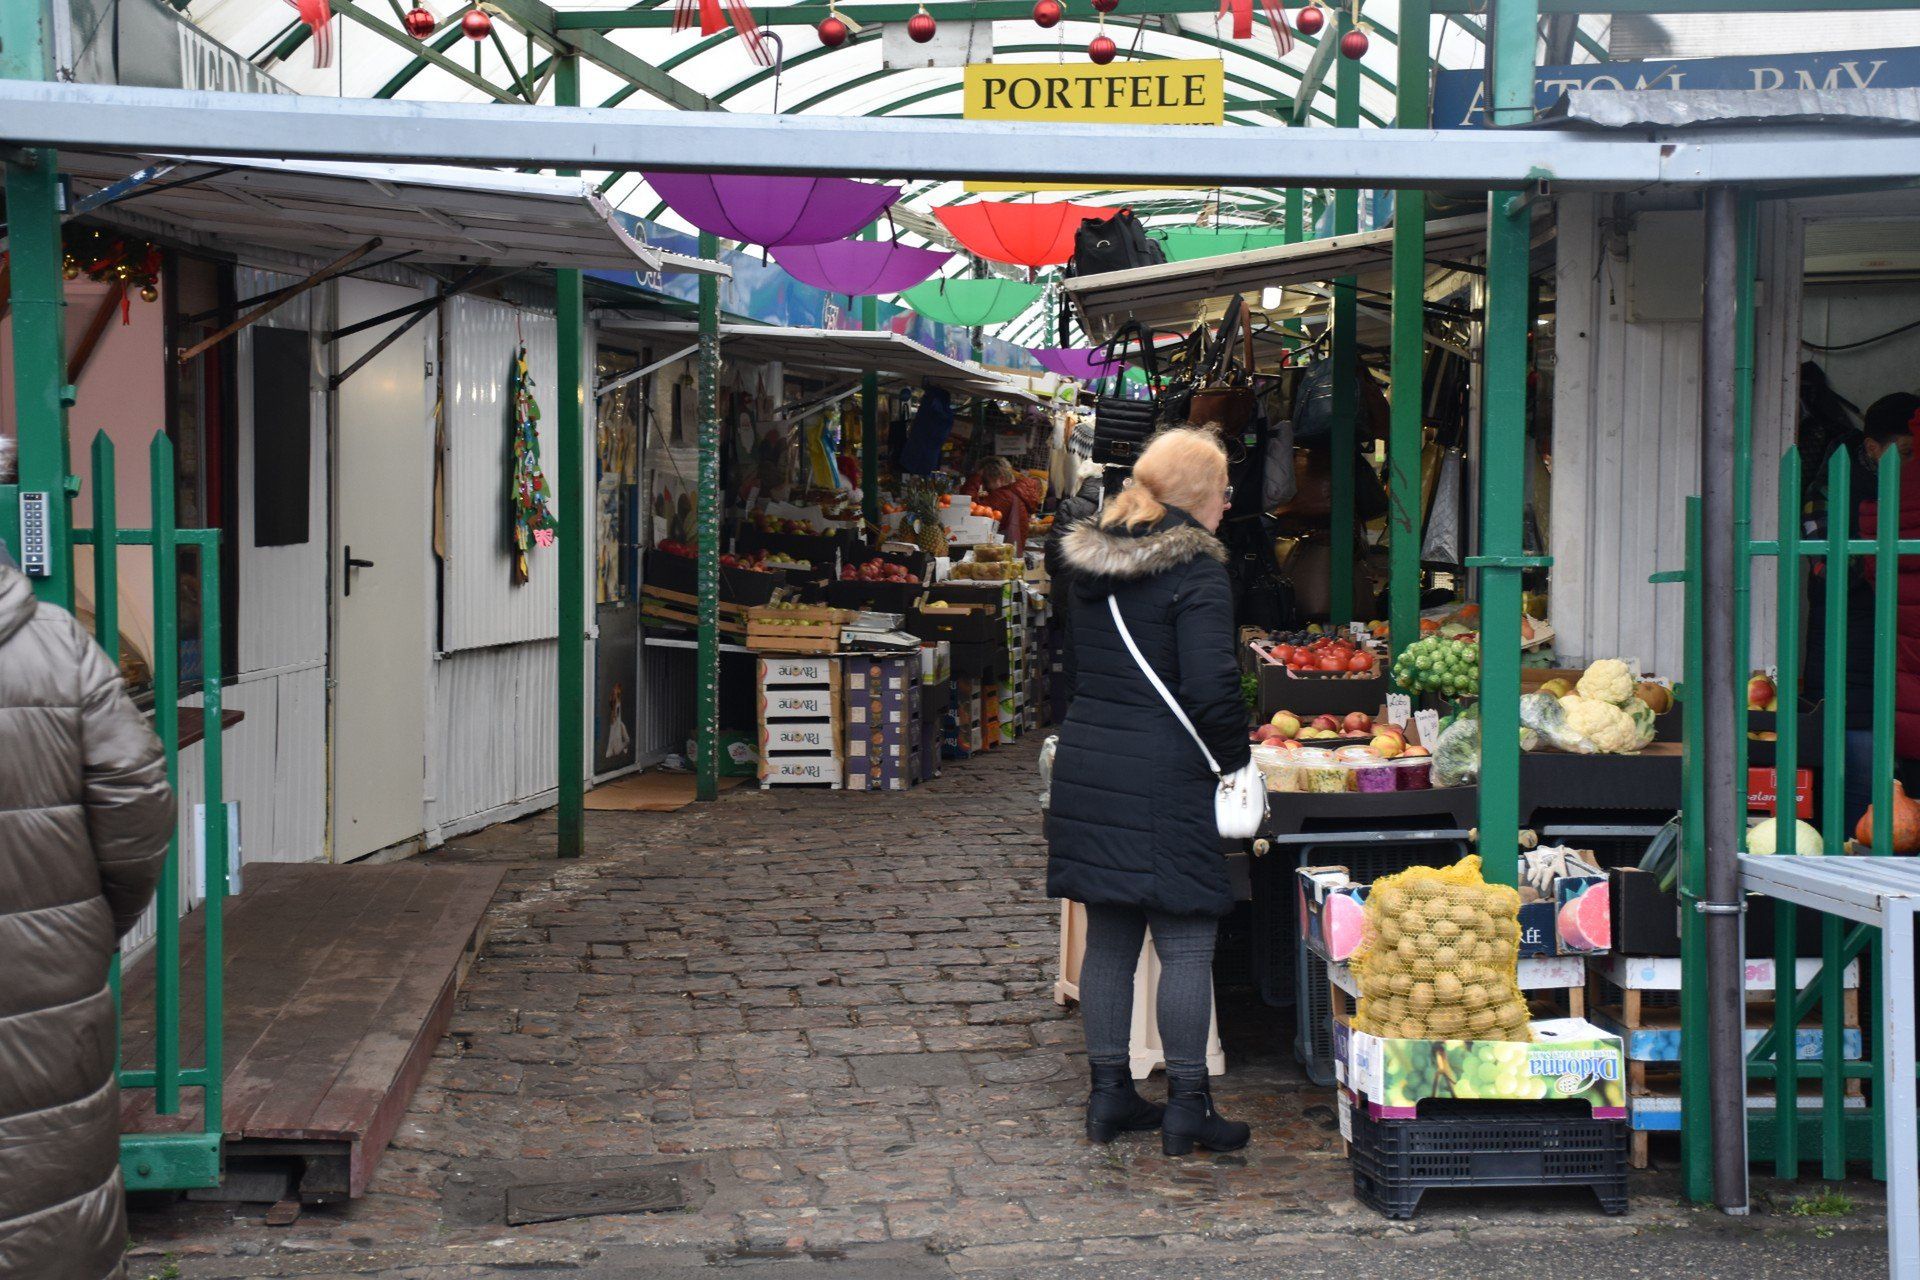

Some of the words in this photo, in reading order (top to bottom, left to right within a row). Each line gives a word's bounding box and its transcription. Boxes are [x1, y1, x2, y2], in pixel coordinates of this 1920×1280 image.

[982, 74, 1207, 110] PORTFELE
[1520, 926, 1542, 944] ÉE
[1529, 1057, 1619, 1081] Didonna
